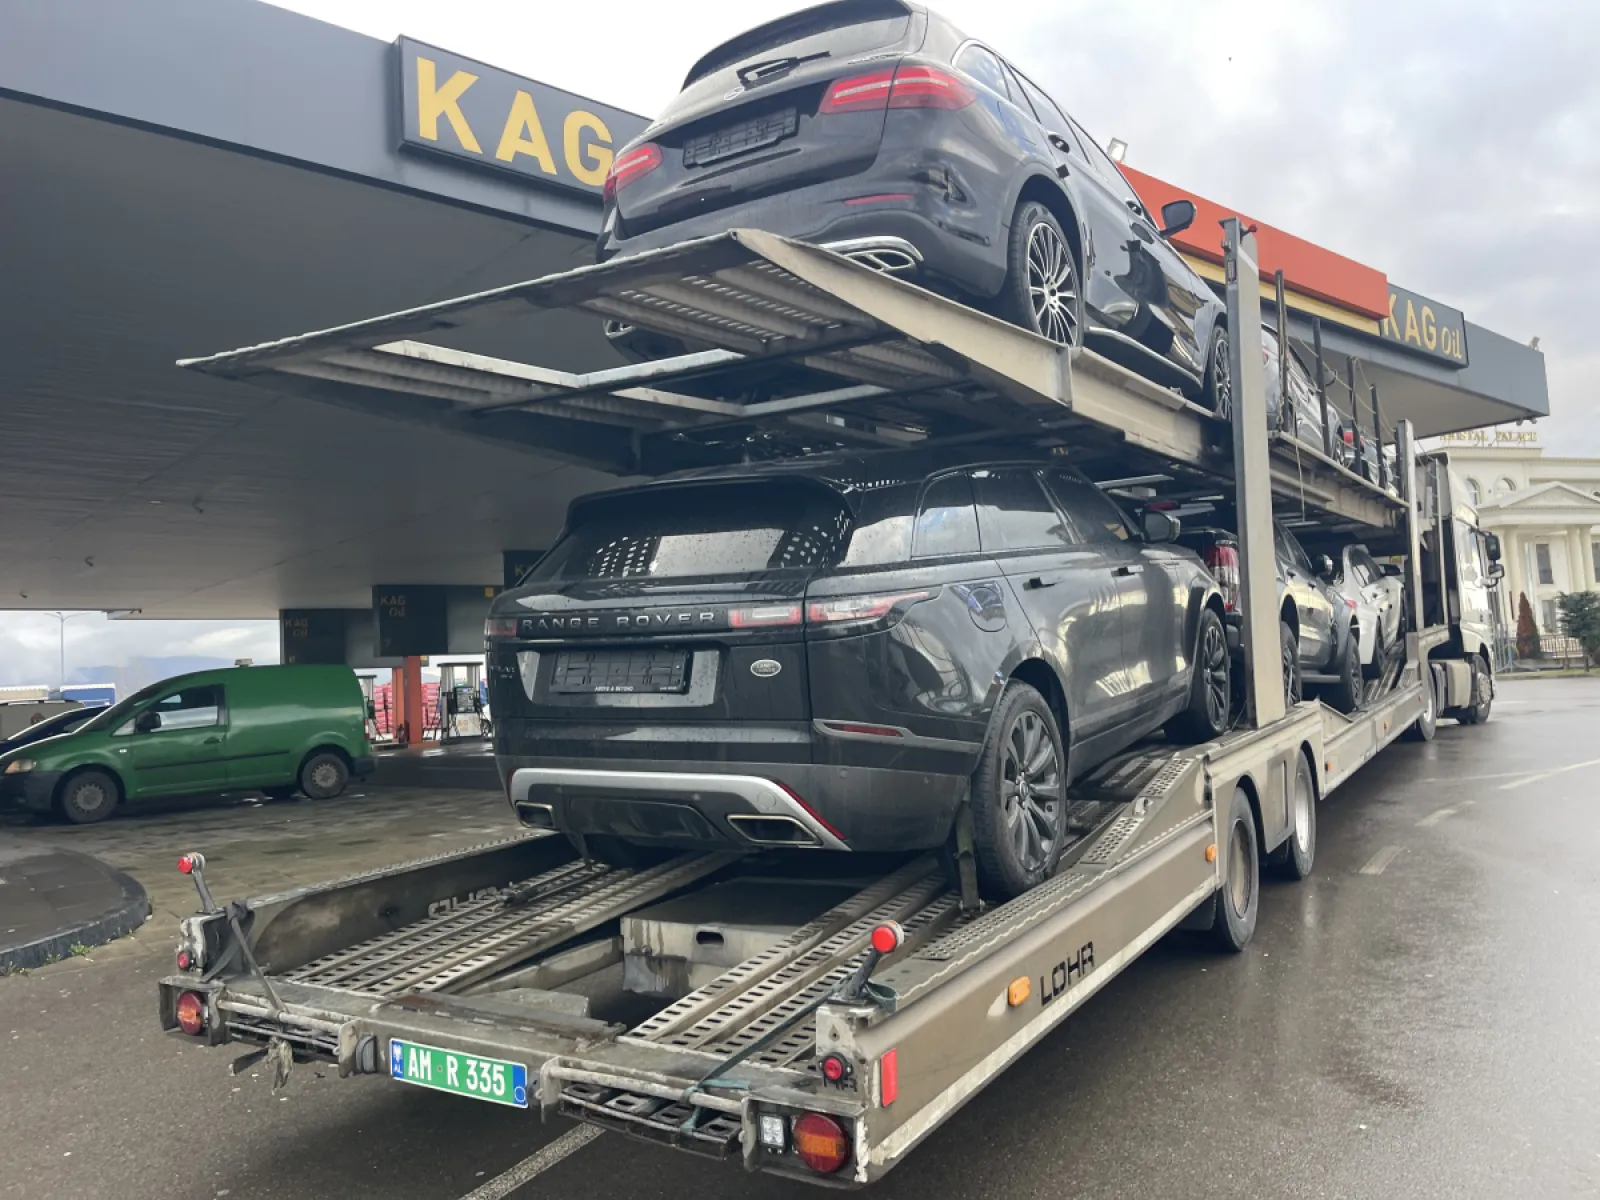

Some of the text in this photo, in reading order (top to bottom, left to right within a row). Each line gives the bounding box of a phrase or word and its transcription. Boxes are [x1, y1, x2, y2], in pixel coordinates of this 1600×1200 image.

[416, 56, 613, 186] KAG
[1385, 293, 1436, 350] KAG
[1496, 432, 1538, 442] PALACE
[380, 594, 406, 606] KAG
[522, 611, 716, 632] RANGE ROVER
[1040, 941, 1095, 1006] LOHR
[394, 1063, 403, 1074] AL
[407, 1047, 506, 1096] AM R 335
